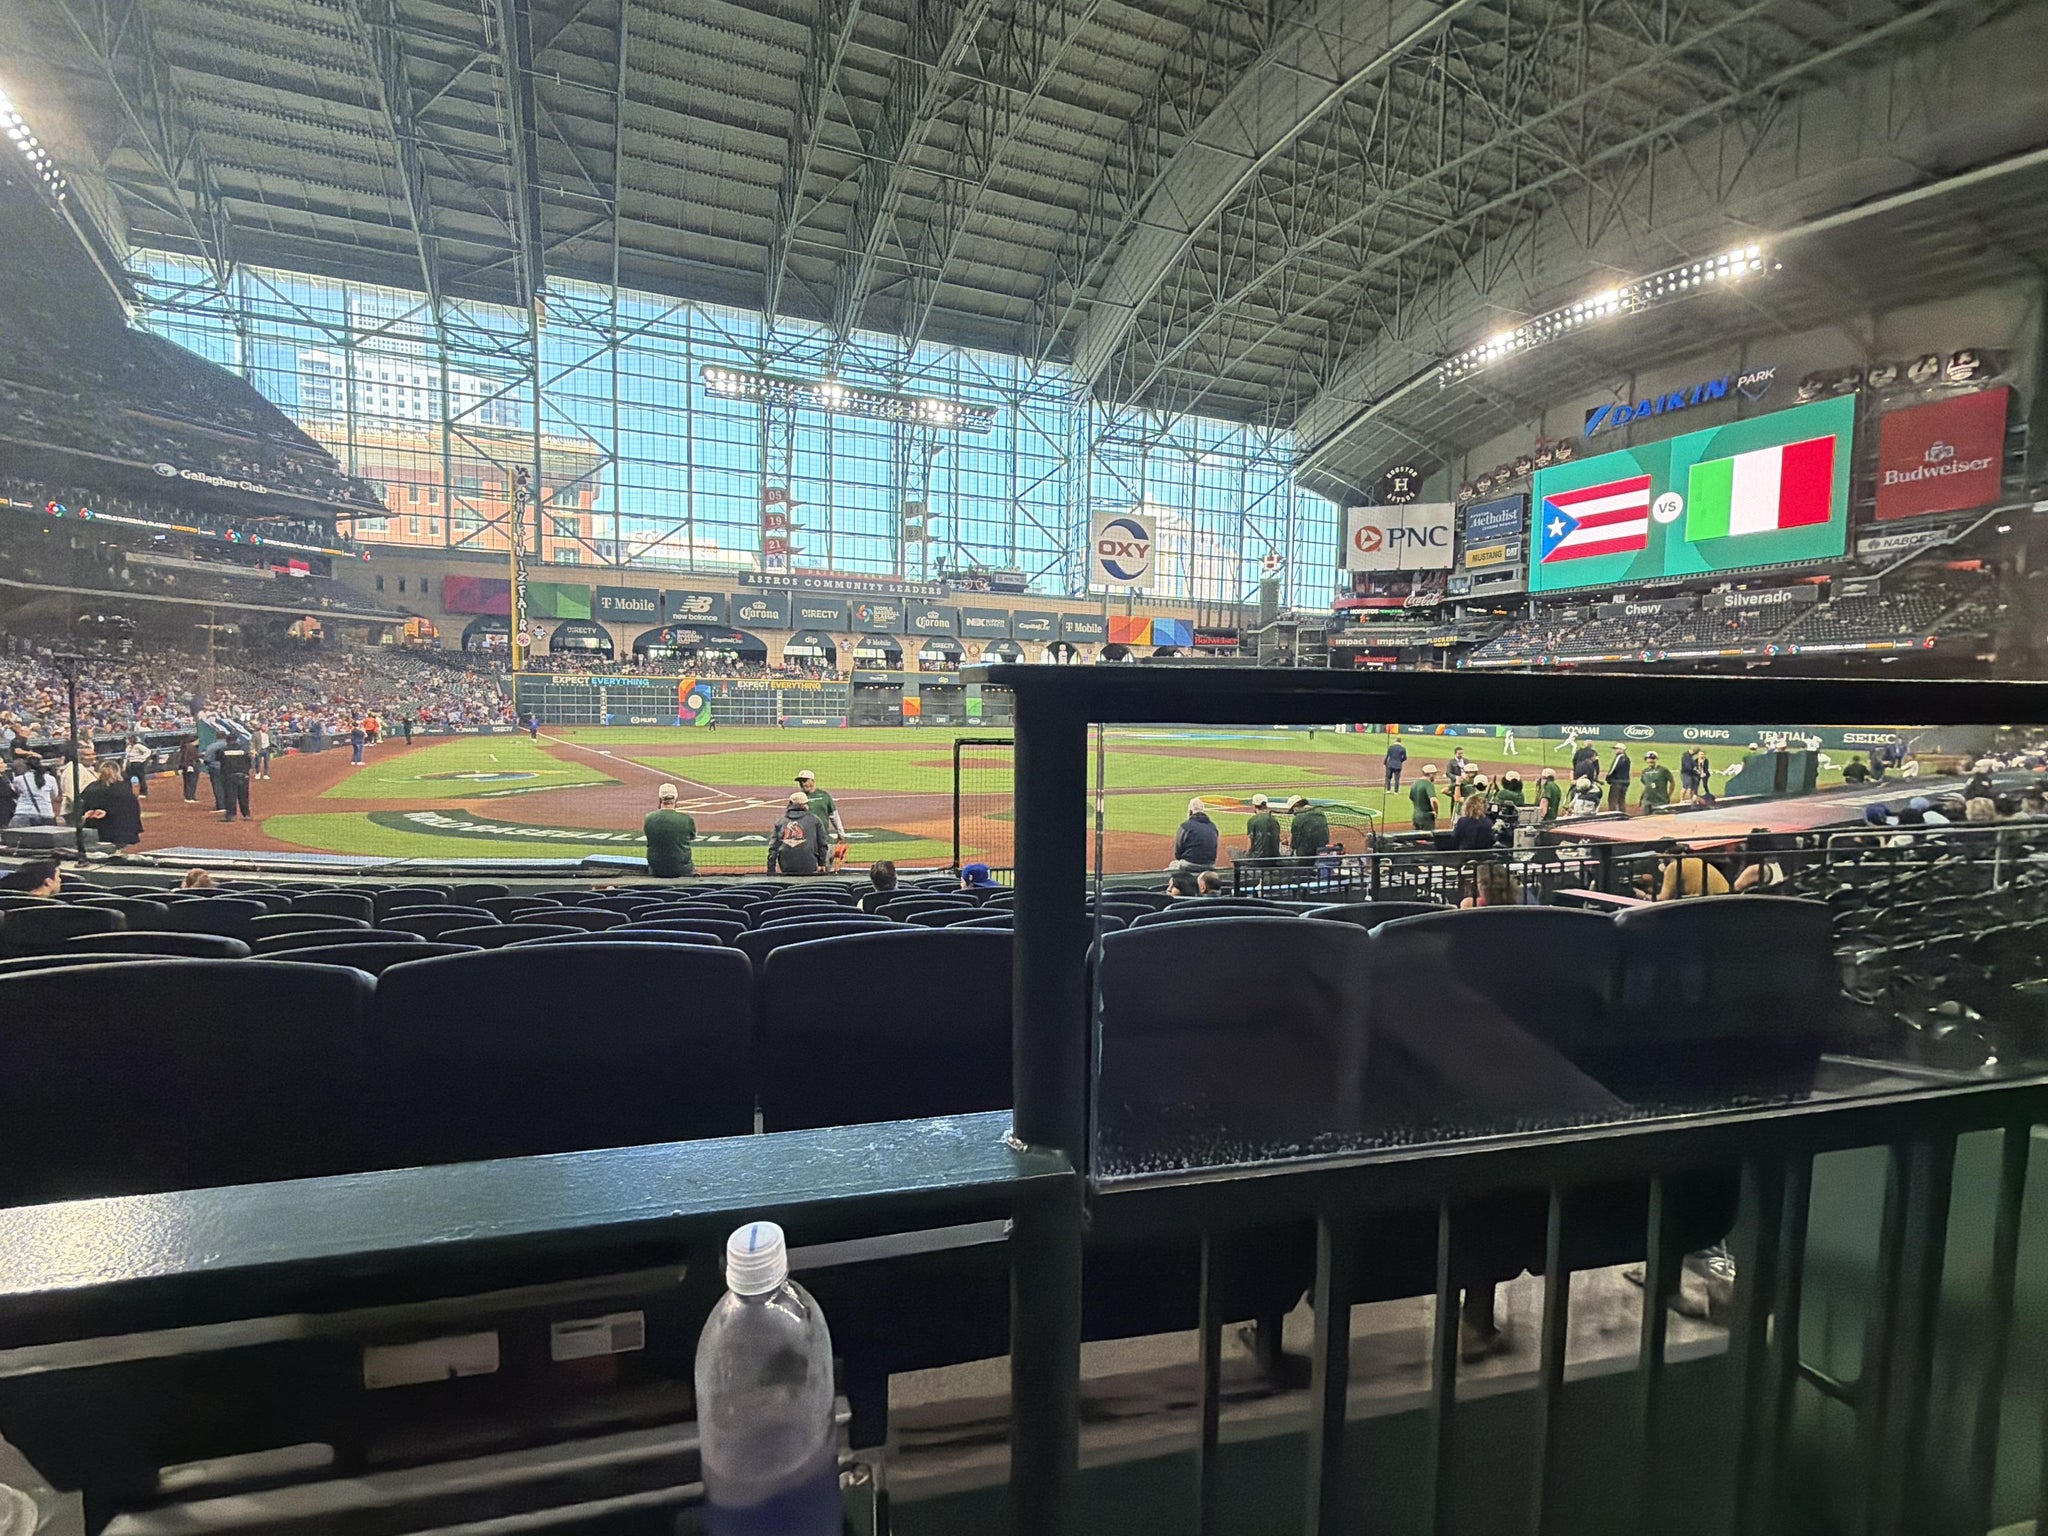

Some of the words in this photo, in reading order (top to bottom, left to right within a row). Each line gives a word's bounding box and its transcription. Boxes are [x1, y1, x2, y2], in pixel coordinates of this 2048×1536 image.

[1737, 367, 1776, 388] PARK
[1611, 376, 1729, 426] DAIKIN
[1883, 458, 1993, 485] Budweiser
[180, 469, 239, 488] Gallagher
[240, 481, 267, 494] Club
[1394, 478, 1408, 491] H
[768, 490, 782, 500] 05
[1658, 501, 1676, 514] VS
[769, 516, 782, 526] 19
[1470, 509, 1518, 528] Methodist
[1386, 526, 1448, 548] PNC
[769, 540, 781, 549] 21
[1099, 540, 1150, 558] OXY
[1472, 550, 1502, 562] MUSTANG
[1506, 547, 1518, 557] CAT
[748, 575, 798, 586] ASTROS
[804, 578, 884, 591] COMMUNITY
[889, 585, 942, 595] LEADERS
[614, 598, 655, 611] Mobile
[1724, 590, 1792, 607] Silverado
[739, 607, 779, 621] Corona
[801, 609, 839, 619] DIRECTV
[1625, 603, 1661, 615] Chevy
[673, 613, 688, 621] new
[689, 613, 718, 622] balance
[916, 616, 950, 630] Corona
[1074, 622, 1103, 633] Mobile
[1194, 634, 1238, 644] Budweiser
[1335, 637, 1367, 646] impact
[1377, 637, 1409, 646] impact
[552, 676, 590, 684] EXPECT
[591, 677, 650, 686] EVERYTHING
[737, 681, 769, 689] EXPECT
[771, 681, 822, 690] EVERYTHING
[1561, 726, 1600, 735] KONAMI
[1700, 730, 1730, 739] MUFG
